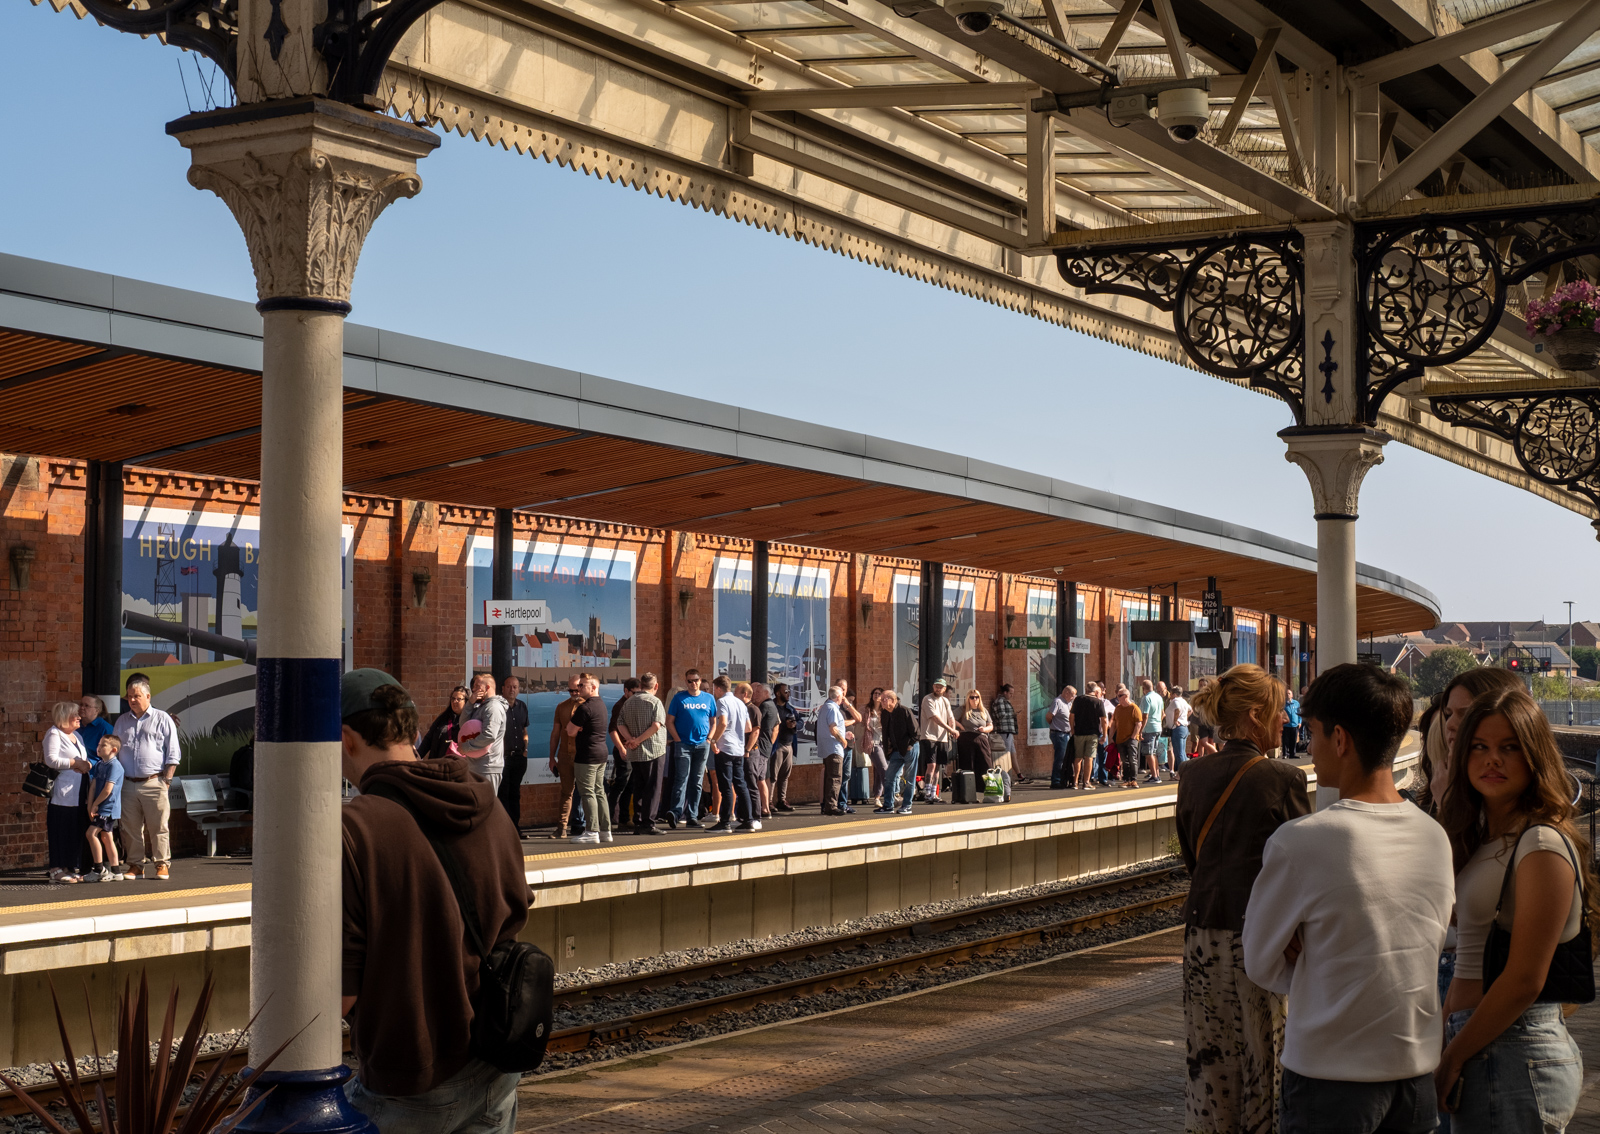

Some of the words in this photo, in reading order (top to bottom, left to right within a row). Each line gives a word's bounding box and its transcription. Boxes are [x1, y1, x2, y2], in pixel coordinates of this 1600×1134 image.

[140, 534, 211, 561] HEUGH
[533, 564, 607, 587] HEADLAND
[789, 583, 824, 601] MARINA
[504, 606, 542, 620] Hartlepool
[907, 607, 920, 620] THE
[945, 609, 964, 624] NAVY
[1203, 608, 1217, 616] OFF
